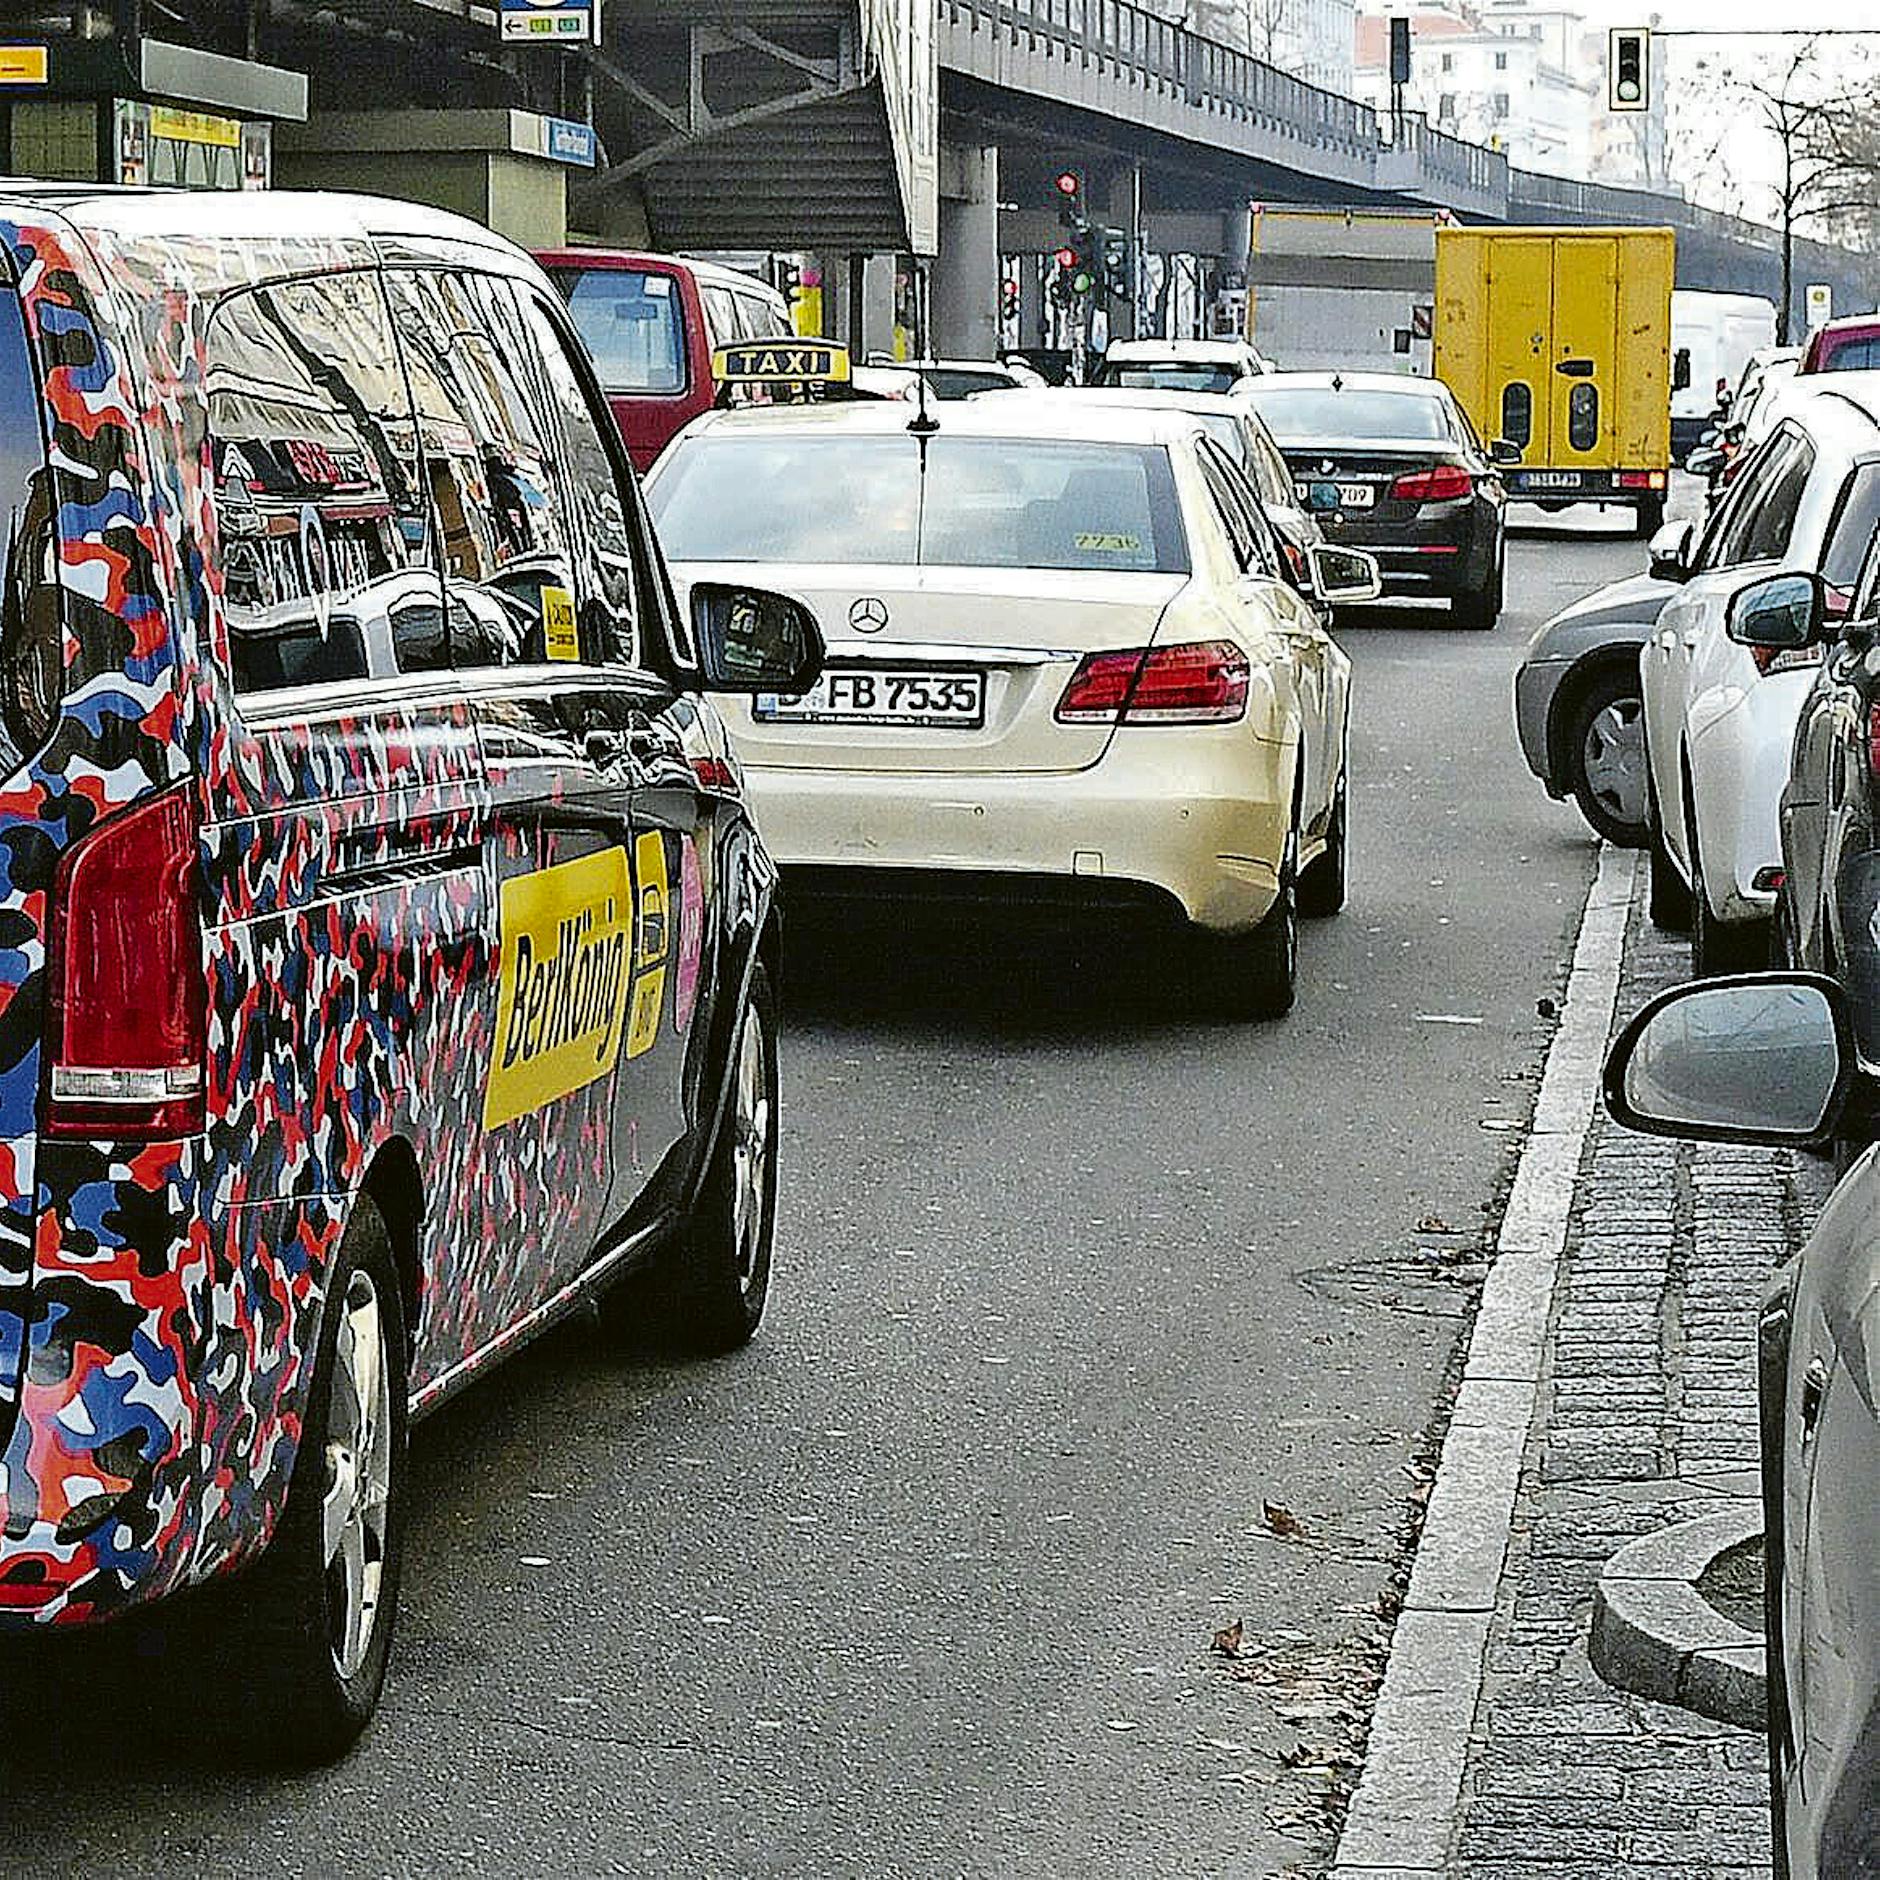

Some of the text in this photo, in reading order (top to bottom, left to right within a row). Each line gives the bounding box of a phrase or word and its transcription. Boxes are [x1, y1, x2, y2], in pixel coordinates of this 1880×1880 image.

[738, 351, 819, 374] TAXI
[828, 675, 875, 709] FB
[885, 677, 978, 711] 7535
[502, 897, 625, 1070] BerlKönig
